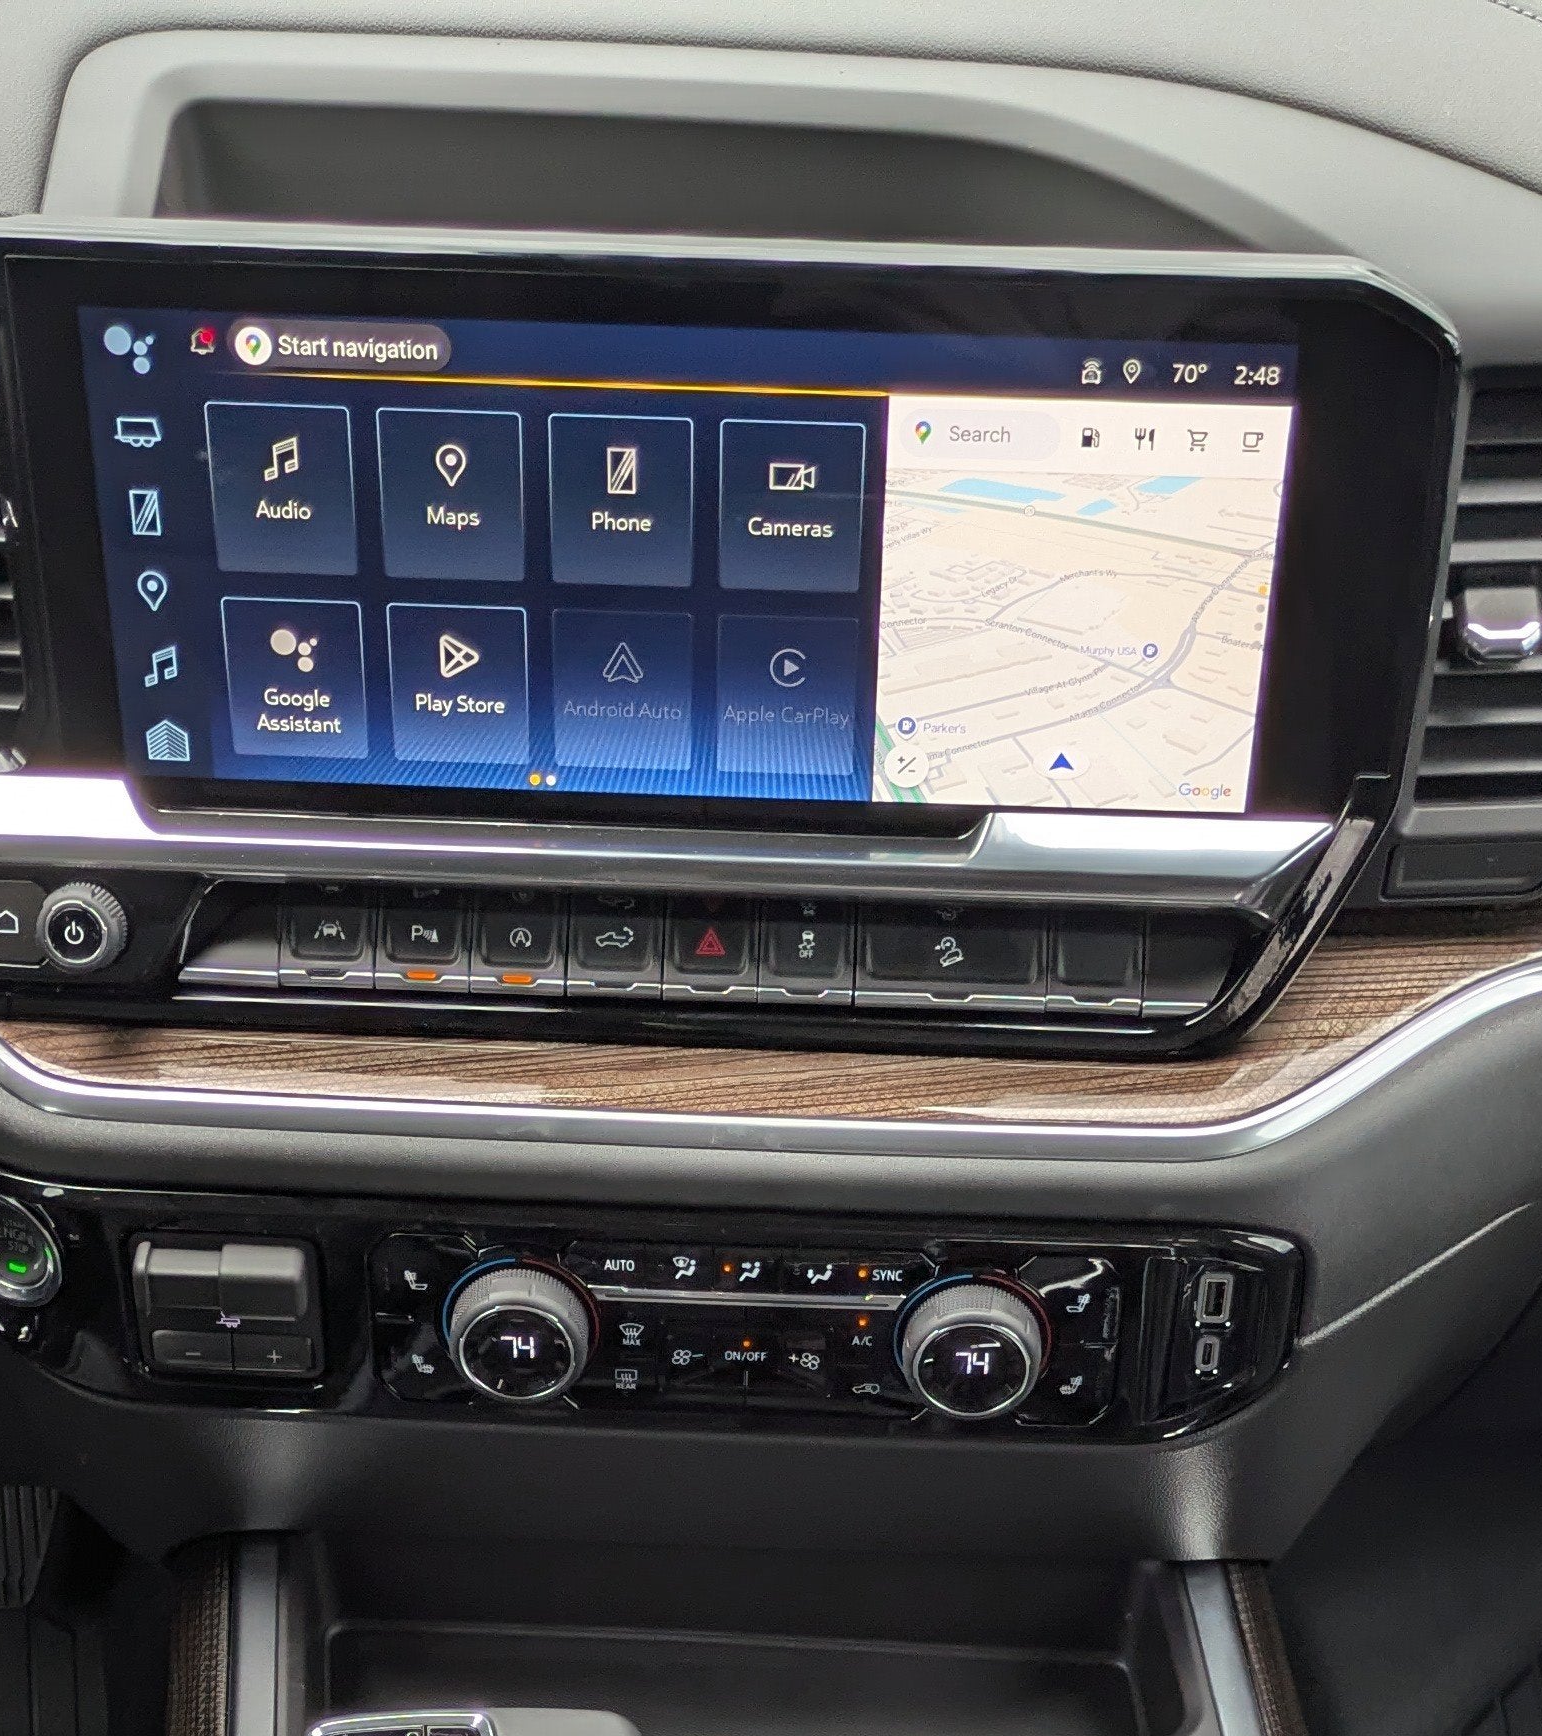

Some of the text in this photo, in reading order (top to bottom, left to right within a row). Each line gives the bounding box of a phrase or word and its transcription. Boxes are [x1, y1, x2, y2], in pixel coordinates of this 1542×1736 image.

[278, 336, 438, 363] Start navigation
[1172, 363, 1208, 383] 70°
[1234, 365, 1281, 386] 2:48
[948, 425, 1011, 445] Search
[257, 501, 312, 521] Audio
[427, 506, 480, 527] Maps
[591, 511, 652, 533] Phone
[748, 517, 834, 538] Cameras
[1059, 569, 1104, 583] Merchant's
[981, 582, 1008, 598] Legacy
[881, 618, 926, 630] Connector
[985, 618, 1070, 650] Scranton Connector
[1080, 645, 1138, 657] Murphy USA
[1025, 684, 1054, 697] Village
[1068, 673, 1094, 687] Glynn
[264, 688, 330, 712] Google
[415, 693, 505, 717] Play Store
[1099, 684, 1142, 710] Connector
[563, 700, 682, 719] Android Auto
[724, 705, 850, 728] Apple CarPlay
[257, 714, 342, 734] Assistant
[923, 723, 966, 734] Parker's
[945, 740, 990, 756] Connector
[1179, 783, 1231, 800] Google
[799, 949, 814, 958] OFF
[604, 1260, 635, 1272] AUTO
[872, 1270, 903, 1282] SYNC
[500, 1336, 535, 1359] 74
[622, 1337, 641, 1346] MAX
[852, 1336, 873, 1347] A/C
[724, 1351, 767, 1362] ON/OFF
[955, 1351, 989, 1374] 74
[615, 1382, 637, 1390] REAR
